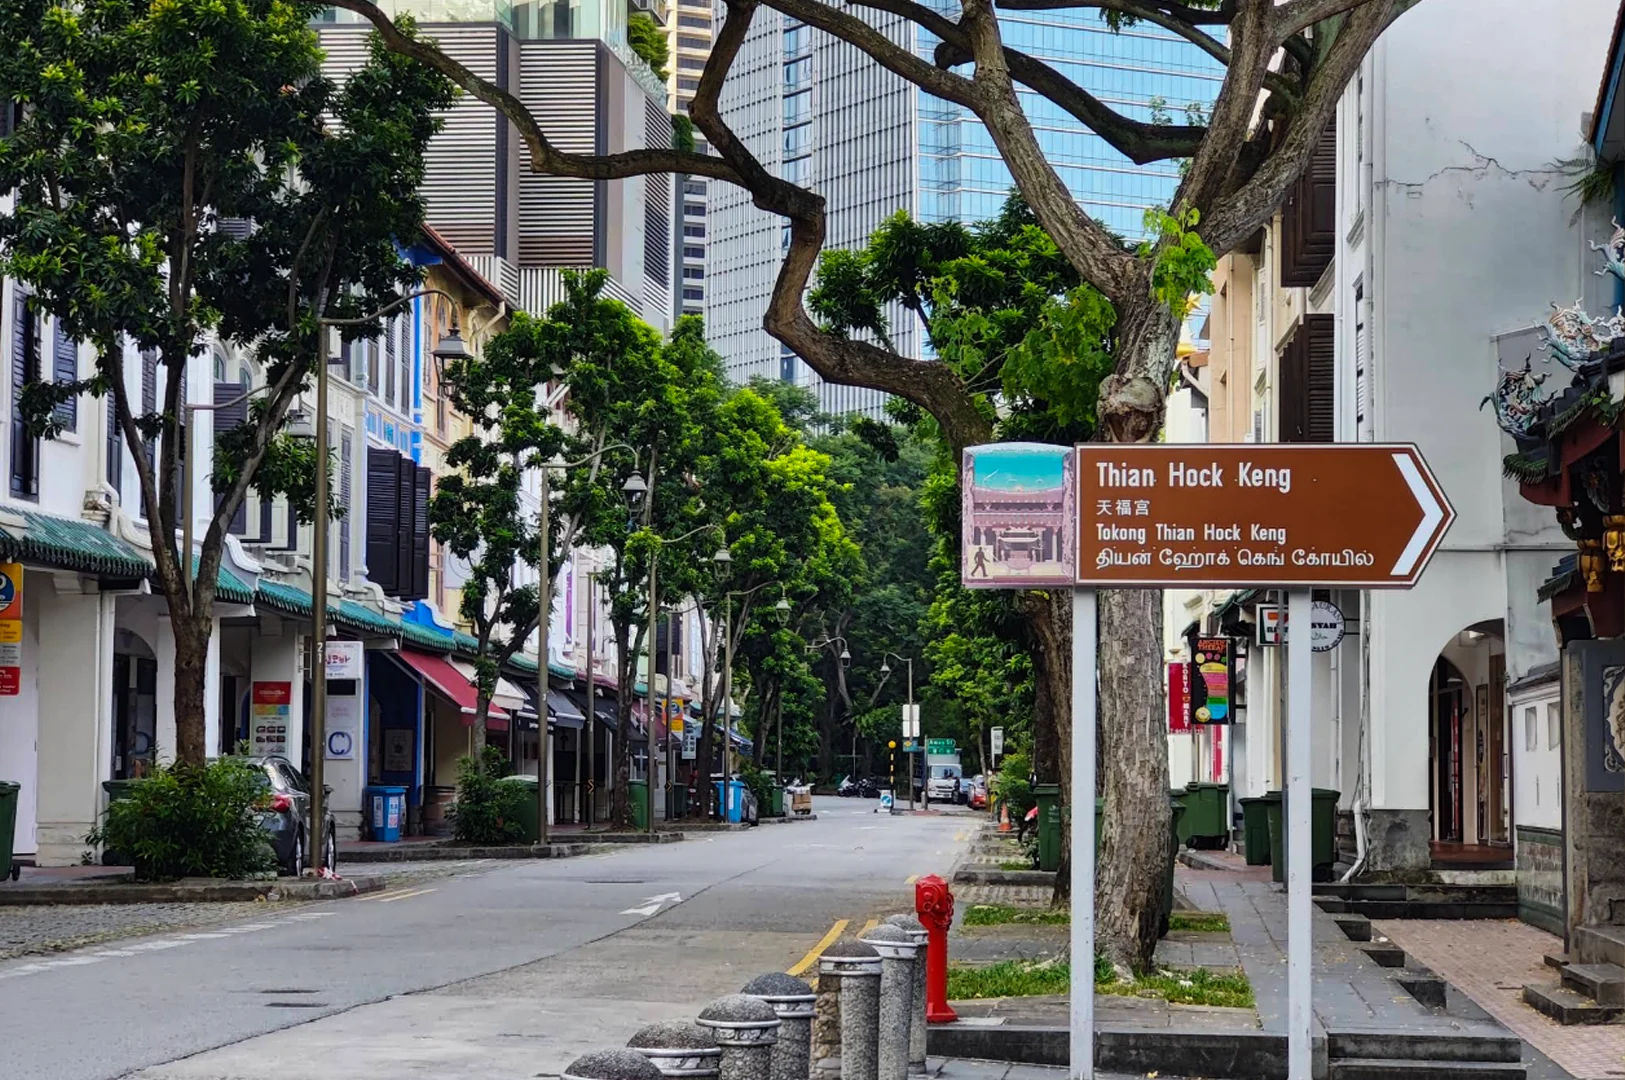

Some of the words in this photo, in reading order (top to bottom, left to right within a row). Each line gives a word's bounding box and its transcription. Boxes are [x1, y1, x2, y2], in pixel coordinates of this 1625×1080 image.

[1096, 462, 1155, 487] Thian
[1168, 462, 1223, 487] Hock
[1238, 462, 1291, 493] Keng
[1096, 499, 1150, 516] 天福宫
[1096, 523, 1146, 544] Tokong
[1156, 523, 1195, 541] Thian
[1204, 523, 1241, 541] Hock
[1251, 523, 1286, 545] Keng
[1096, 548, 1152, 570] தியன்
[1159, 548, 1231, 570] ஹோக்
[1291, 548, 1375, 566] கோயில்
